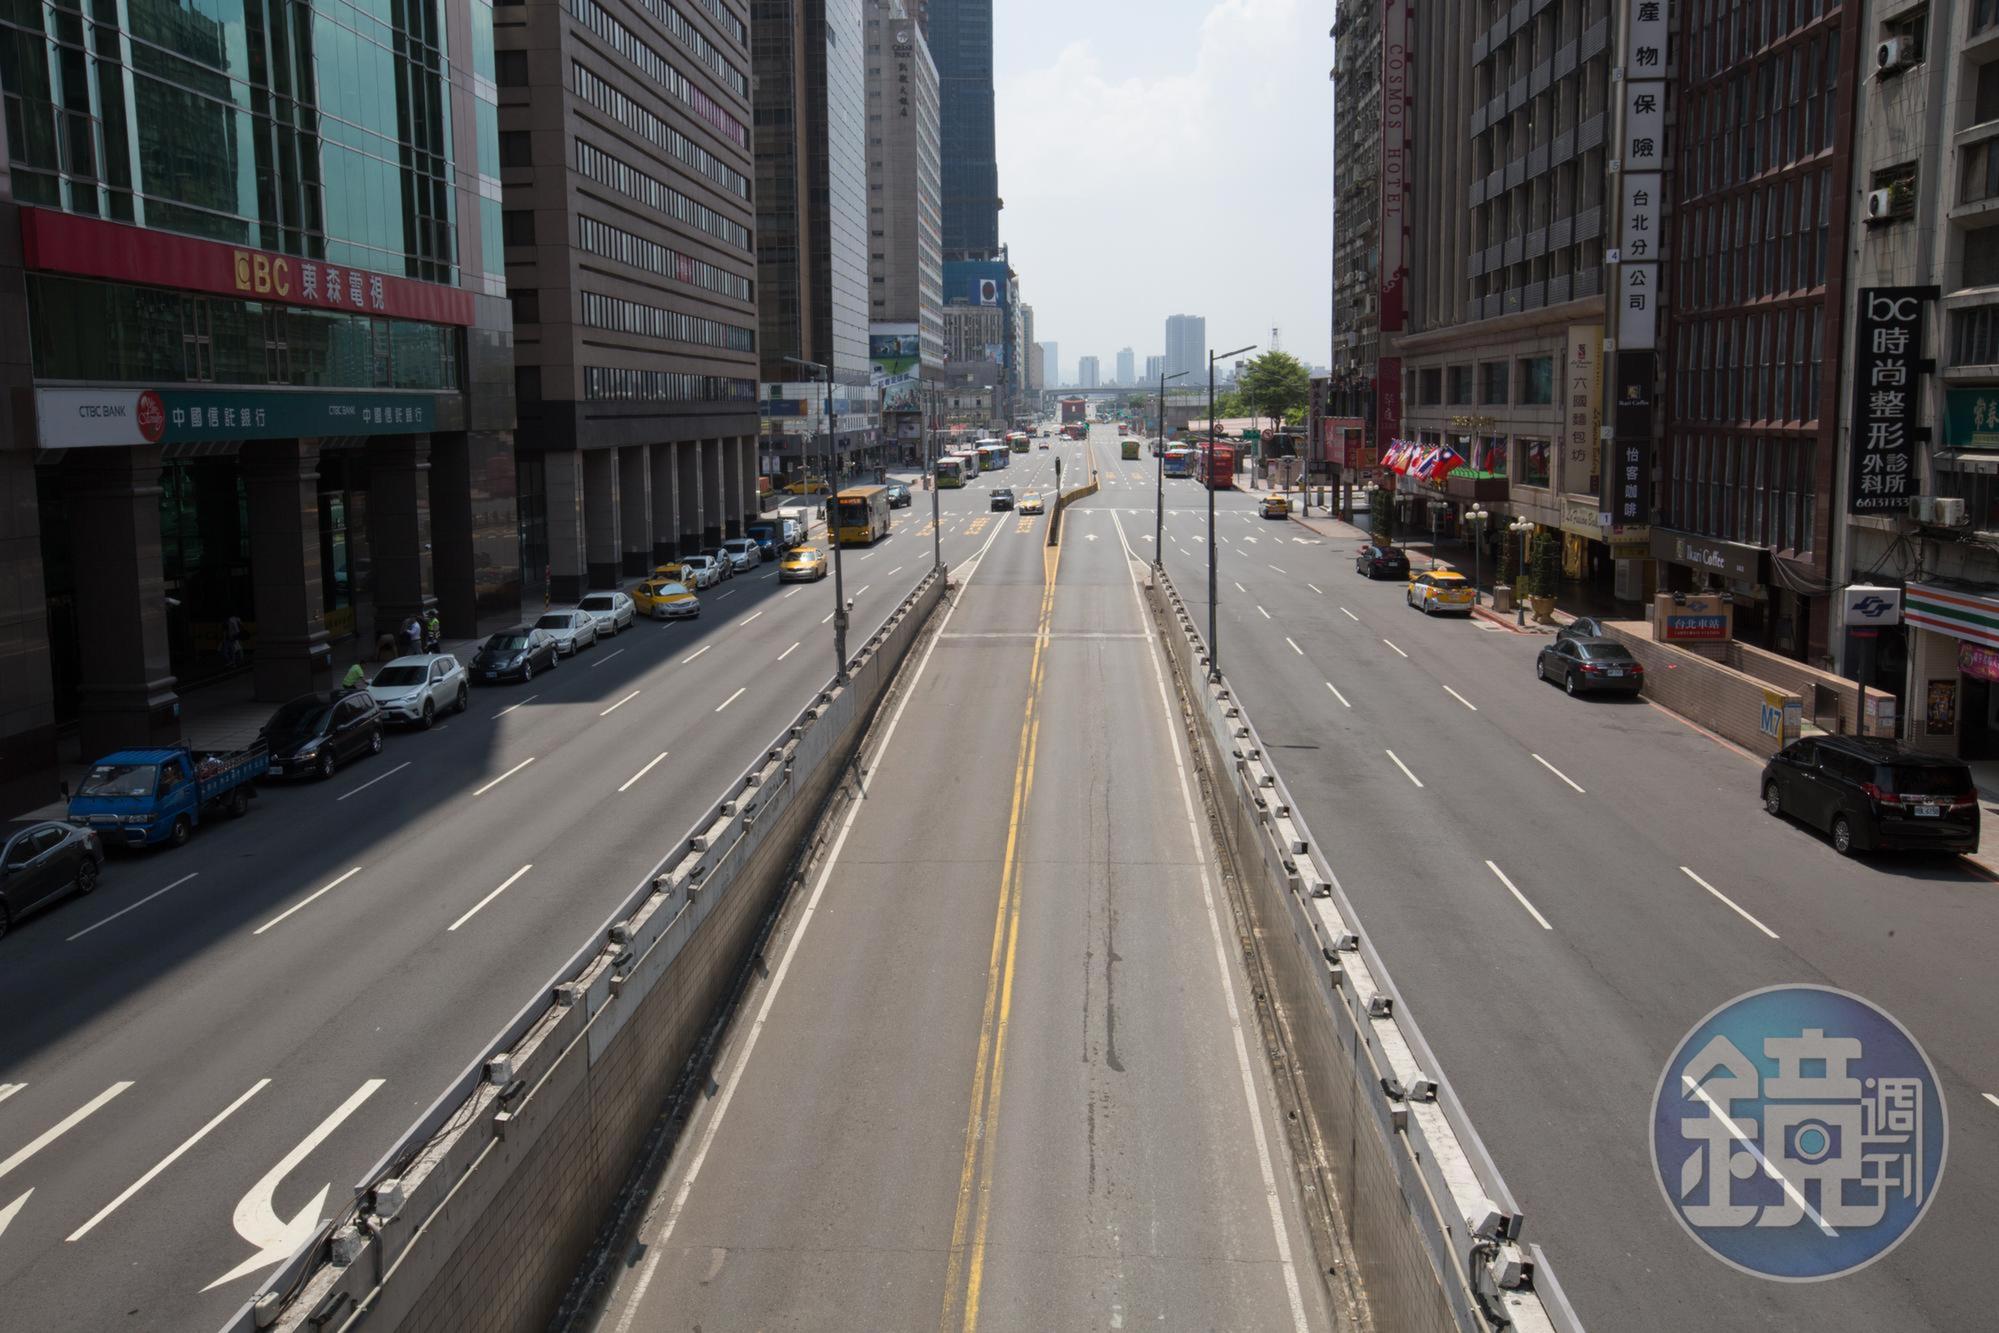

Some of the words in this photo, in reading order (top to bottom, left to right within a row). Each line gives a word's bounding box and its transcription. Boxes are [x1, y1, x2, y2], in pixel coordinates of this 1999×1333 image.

[1388, 44, 1403, 130] COSMOS
[1386, 149, 1401, 219] HOTEL
[234, 250, 289, 297] EBC
[302, 264, 385, 311] 東森電視
[1867, 327, 1910, 449] 時尚整形
[79, 404, 102, 418] CTBC
[103, 405, 126, 418] BANK
[172, 406, 266, 429] 中國信託銀行
[328, 405, 342, 416] CTBC
[343, 406, 356, 416] BANK
[362, 408, 423, 424] 中國信託銀行
[1571, 377, 1587, 463] 六國麵包坊
[1624, 447, 1640, 518] 怡客咖啡
[1702, 548, 1725, 569] Coffee
[1674, 617, 1720, 630] 台北車站
[1760, 703, 1782, 736] M7
